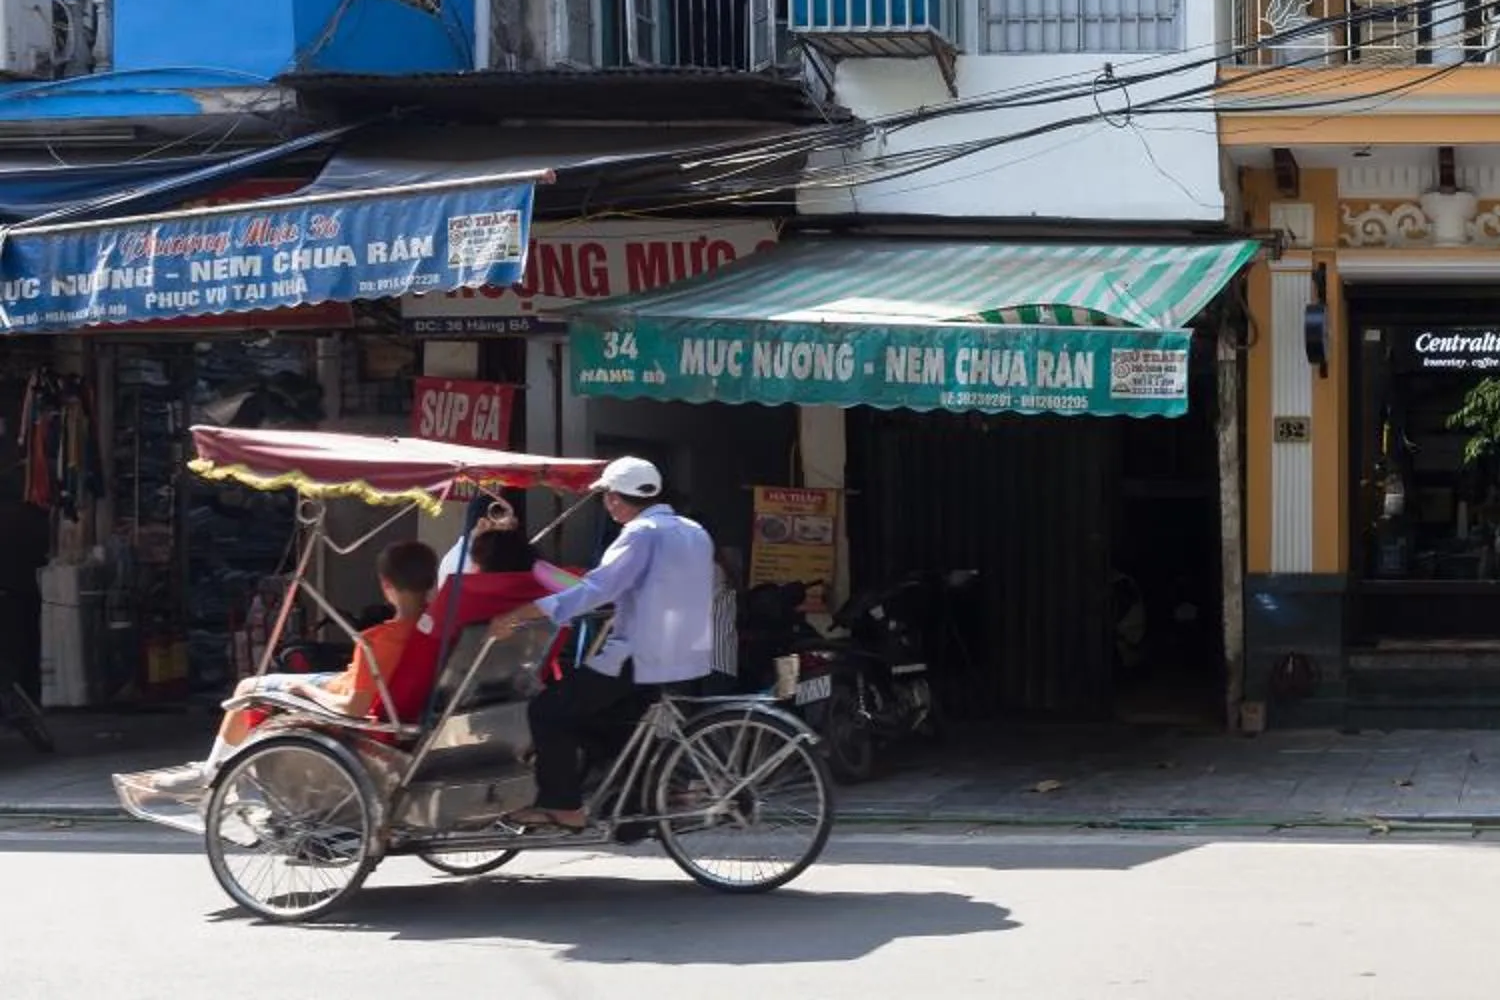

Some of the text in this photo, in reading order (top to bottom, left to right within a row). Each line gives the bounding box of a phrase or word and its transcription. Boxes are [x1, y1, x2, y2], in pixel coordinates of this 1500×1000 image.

[0, 276, 40, 307] ỰC
[190, 254, 262, 283] NEM
[273, 245, 357, 274] CHUA
[367, 234, 433, 265] RÁN
[145, 290, 200, 312] PHỤC
[206, 286, 227, 306] VỤ
[235, 284, 266, 304] TẠI
[602, 331, 638, 360] 34
[680, 338, 743, 388] MỰC
[885, 346, 945, 385] NEM
[954, 347, 1028, 389] CHUA
[1036, 342, 1094, 390] RÁN
[1471, 357, 1499, 369] coffee
[419, 381, 470, 440] SÚP
